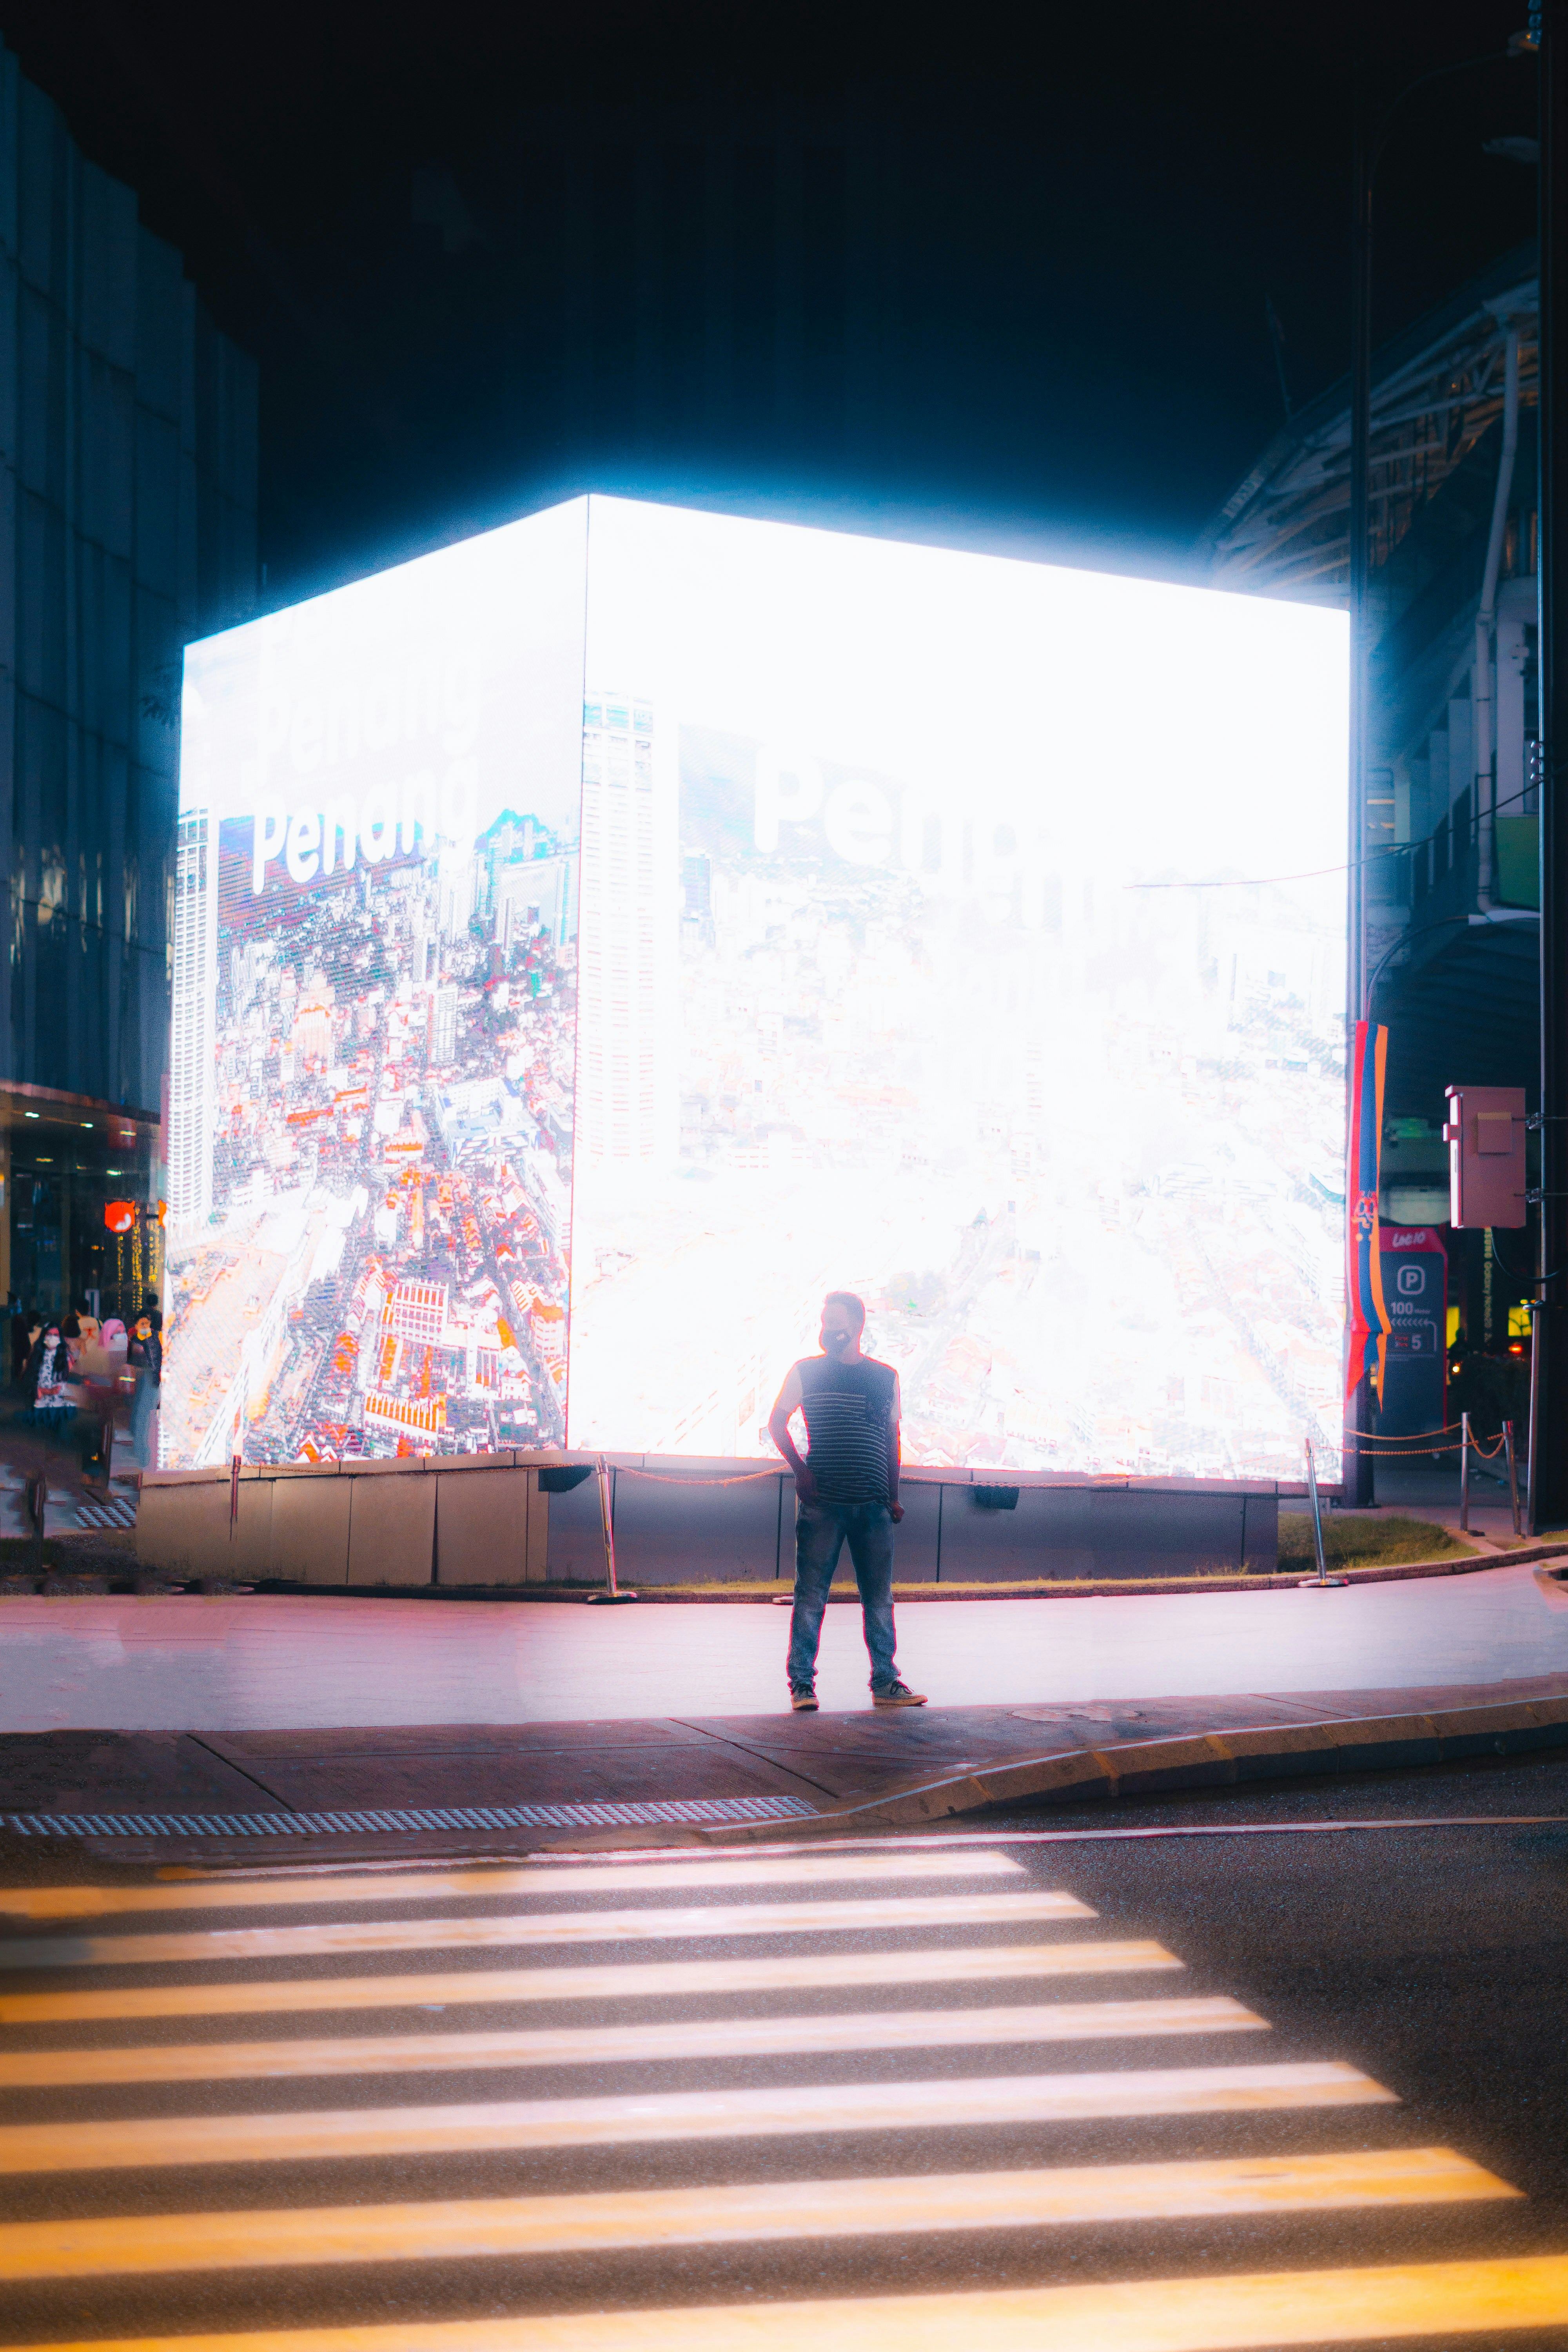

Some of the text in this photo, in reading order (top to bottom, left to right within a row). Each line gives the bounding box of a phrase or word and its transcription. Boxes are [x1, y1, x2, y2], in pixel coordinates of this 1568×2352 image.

[256, 643, 481, 788] Penang
[254, 756, 478, 893] Penang
[1406, 1272, 1418, 1288] P
[1391, 1302, 1413, 1314] 100
[1412, 1335, 1421, 1350] 5
